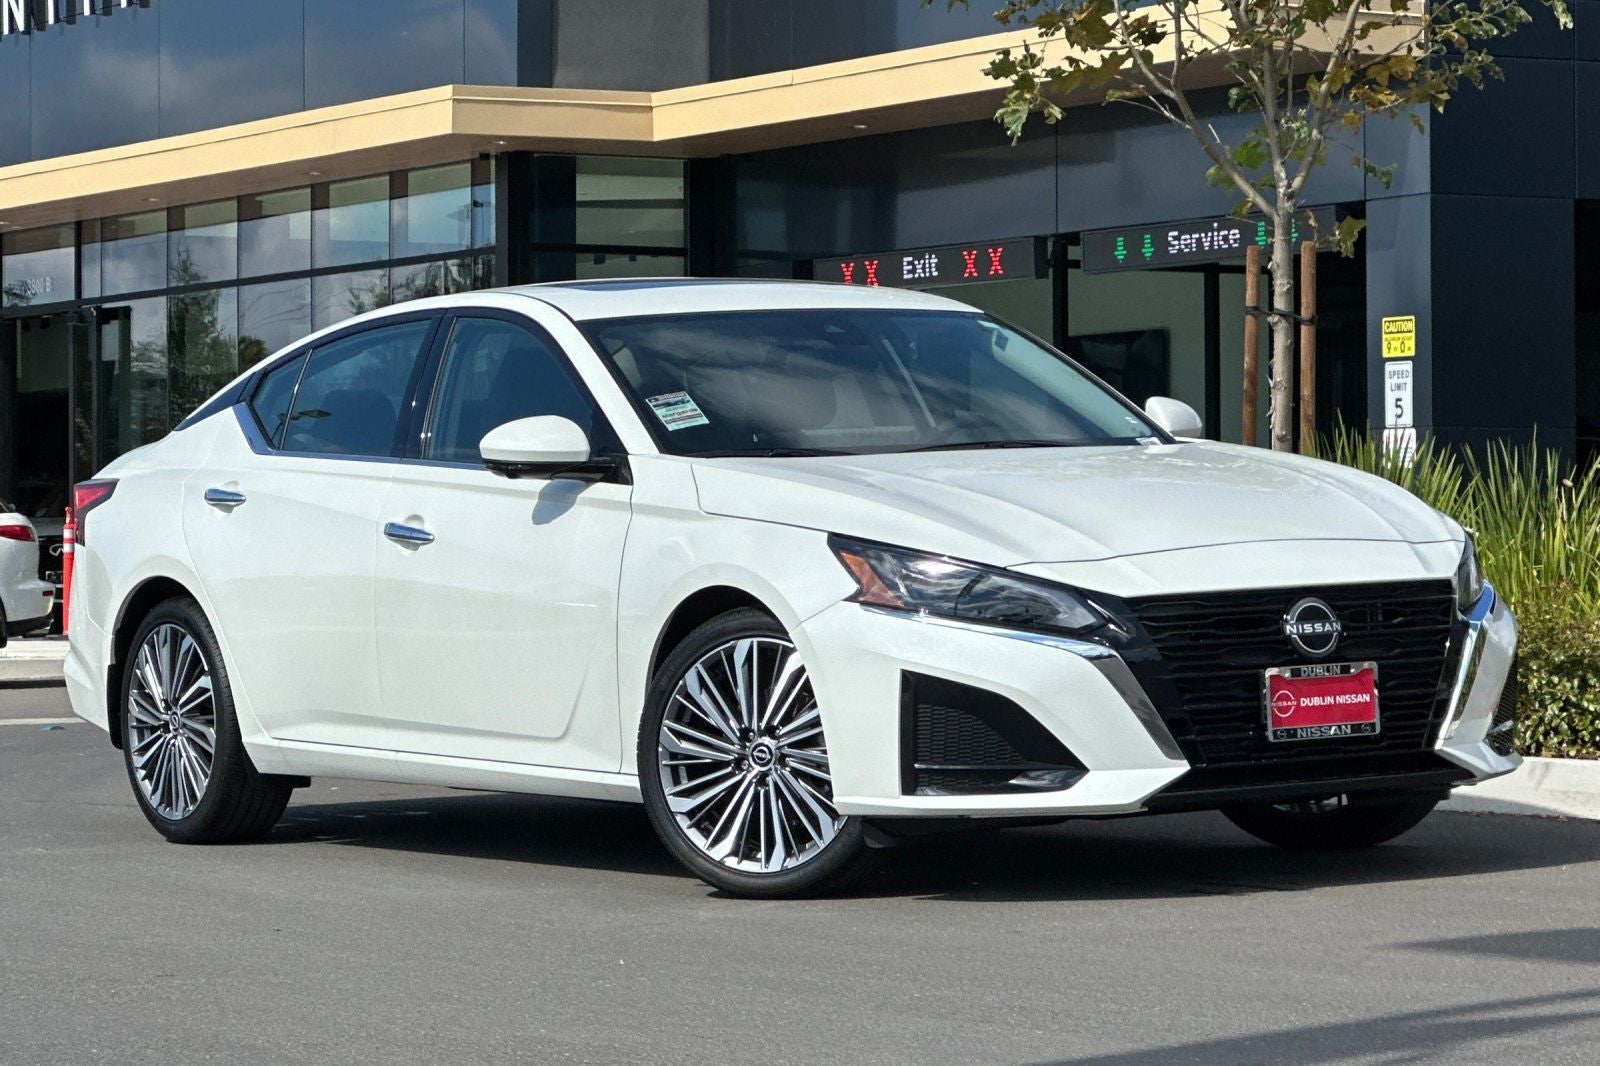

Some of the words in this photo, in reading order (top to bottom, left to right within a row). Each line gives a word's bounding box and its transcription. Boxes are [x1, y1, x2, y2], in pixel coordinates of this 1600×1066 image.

[1167, 222, 1241, 254] Service
[902, 252, 939, 279] Exit
[1385, 320, 1413, 332] CAUTION
[1386, 341, 1392, 354] 9
[1400, 341, 1406, 353] 0
[1388, 369, 1410, 379] SPEED
[1390, 382, 1408, 392] LIMIT
[1395, 398, 1404, 418] 5
[1286, 622, 1341, 634] NISSAN
[1300, 665, 1341, 677] DUBLIN
[1300, 695, 1334, 707] DUBLIN
[1336, 693, 1371, 704] NISSAN
[1297, 725, 1351, 738] NISSAN
